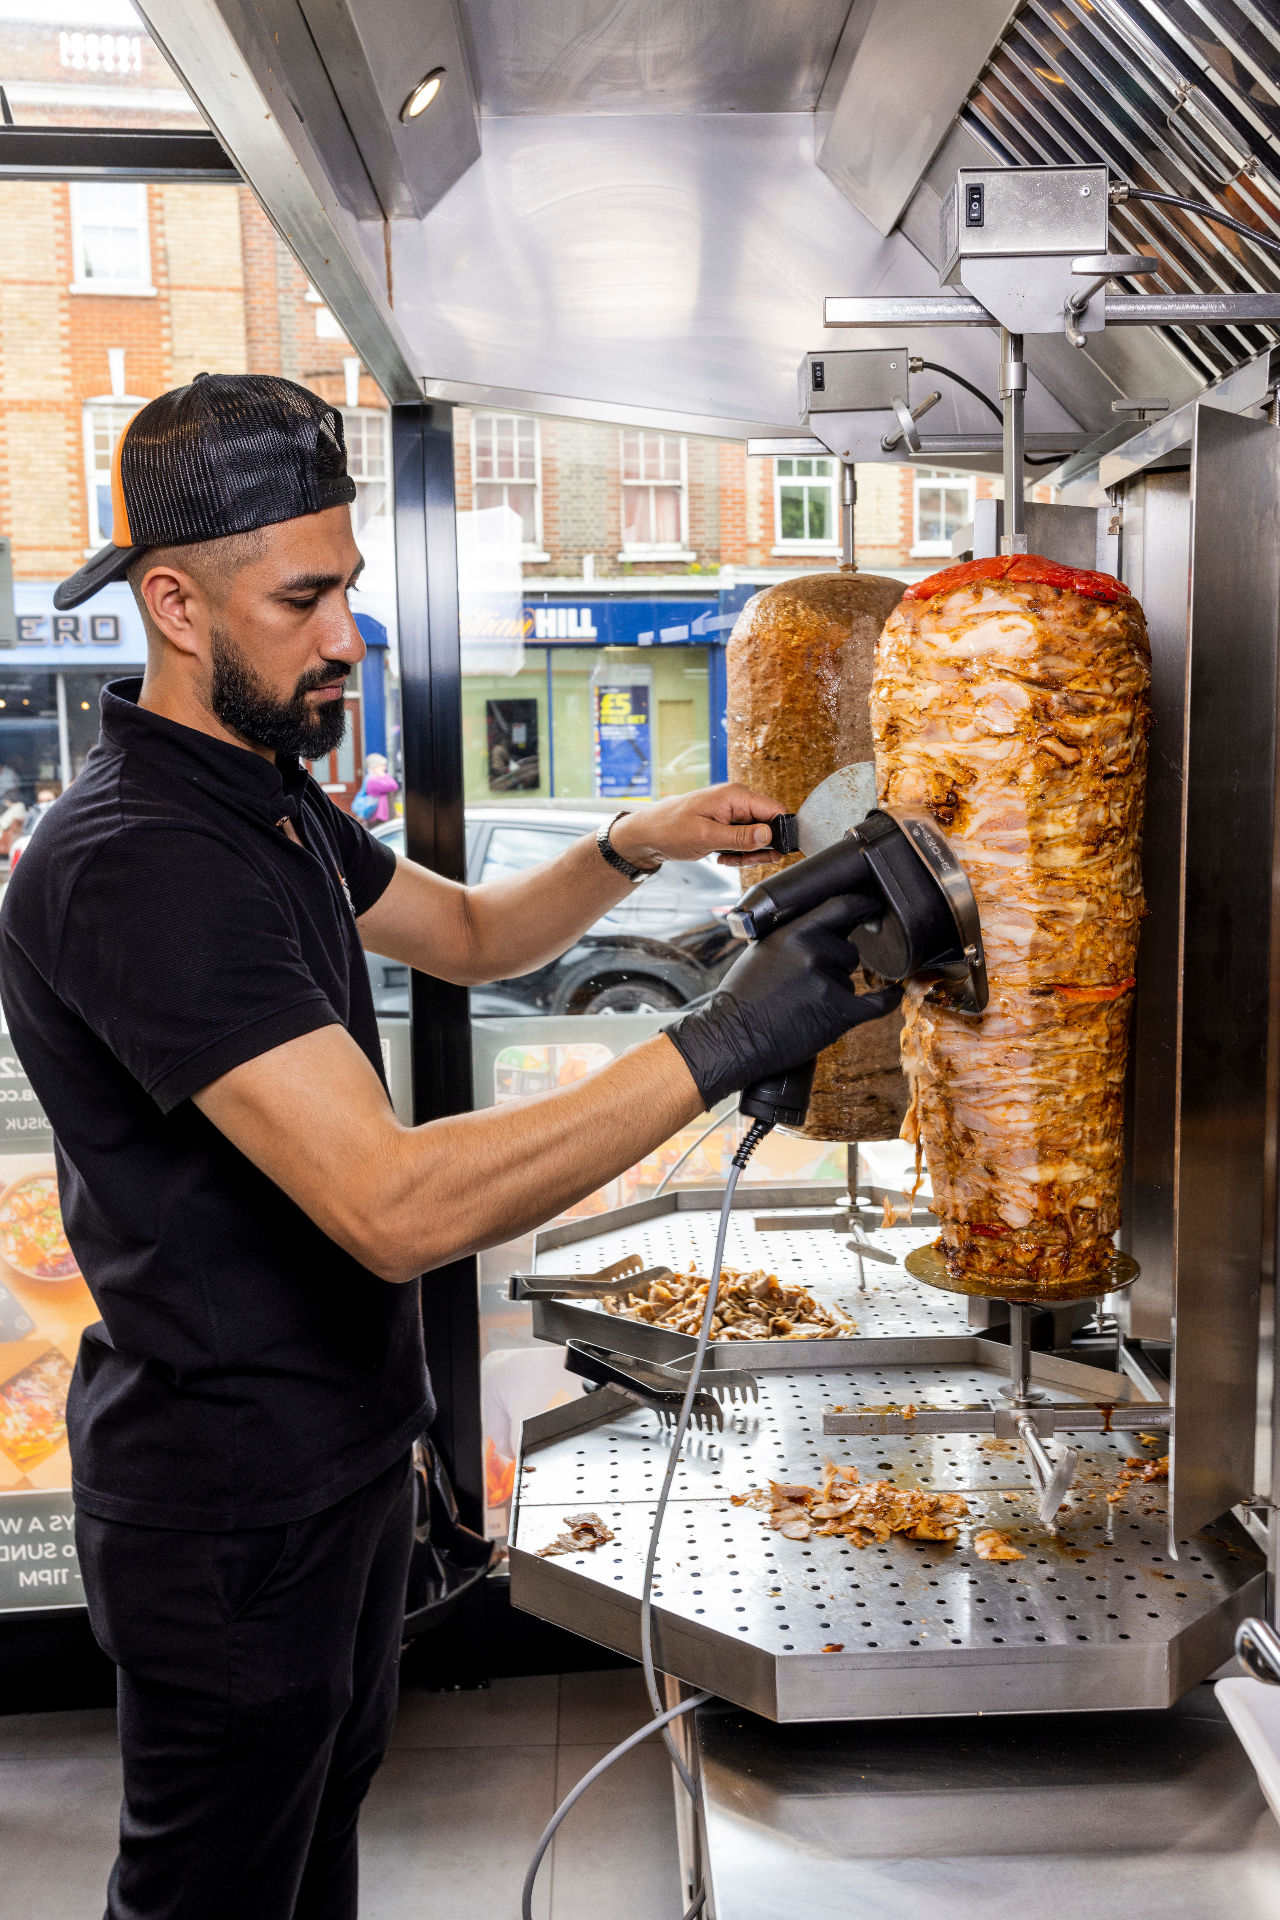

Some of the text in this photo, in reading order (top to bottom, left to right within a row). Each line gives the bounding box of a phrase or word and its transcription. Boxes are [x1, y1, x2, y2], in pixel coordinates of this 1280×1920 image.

[459, 606, 598, 638] illiam HILL
[600, 693, 632, 715] £5
